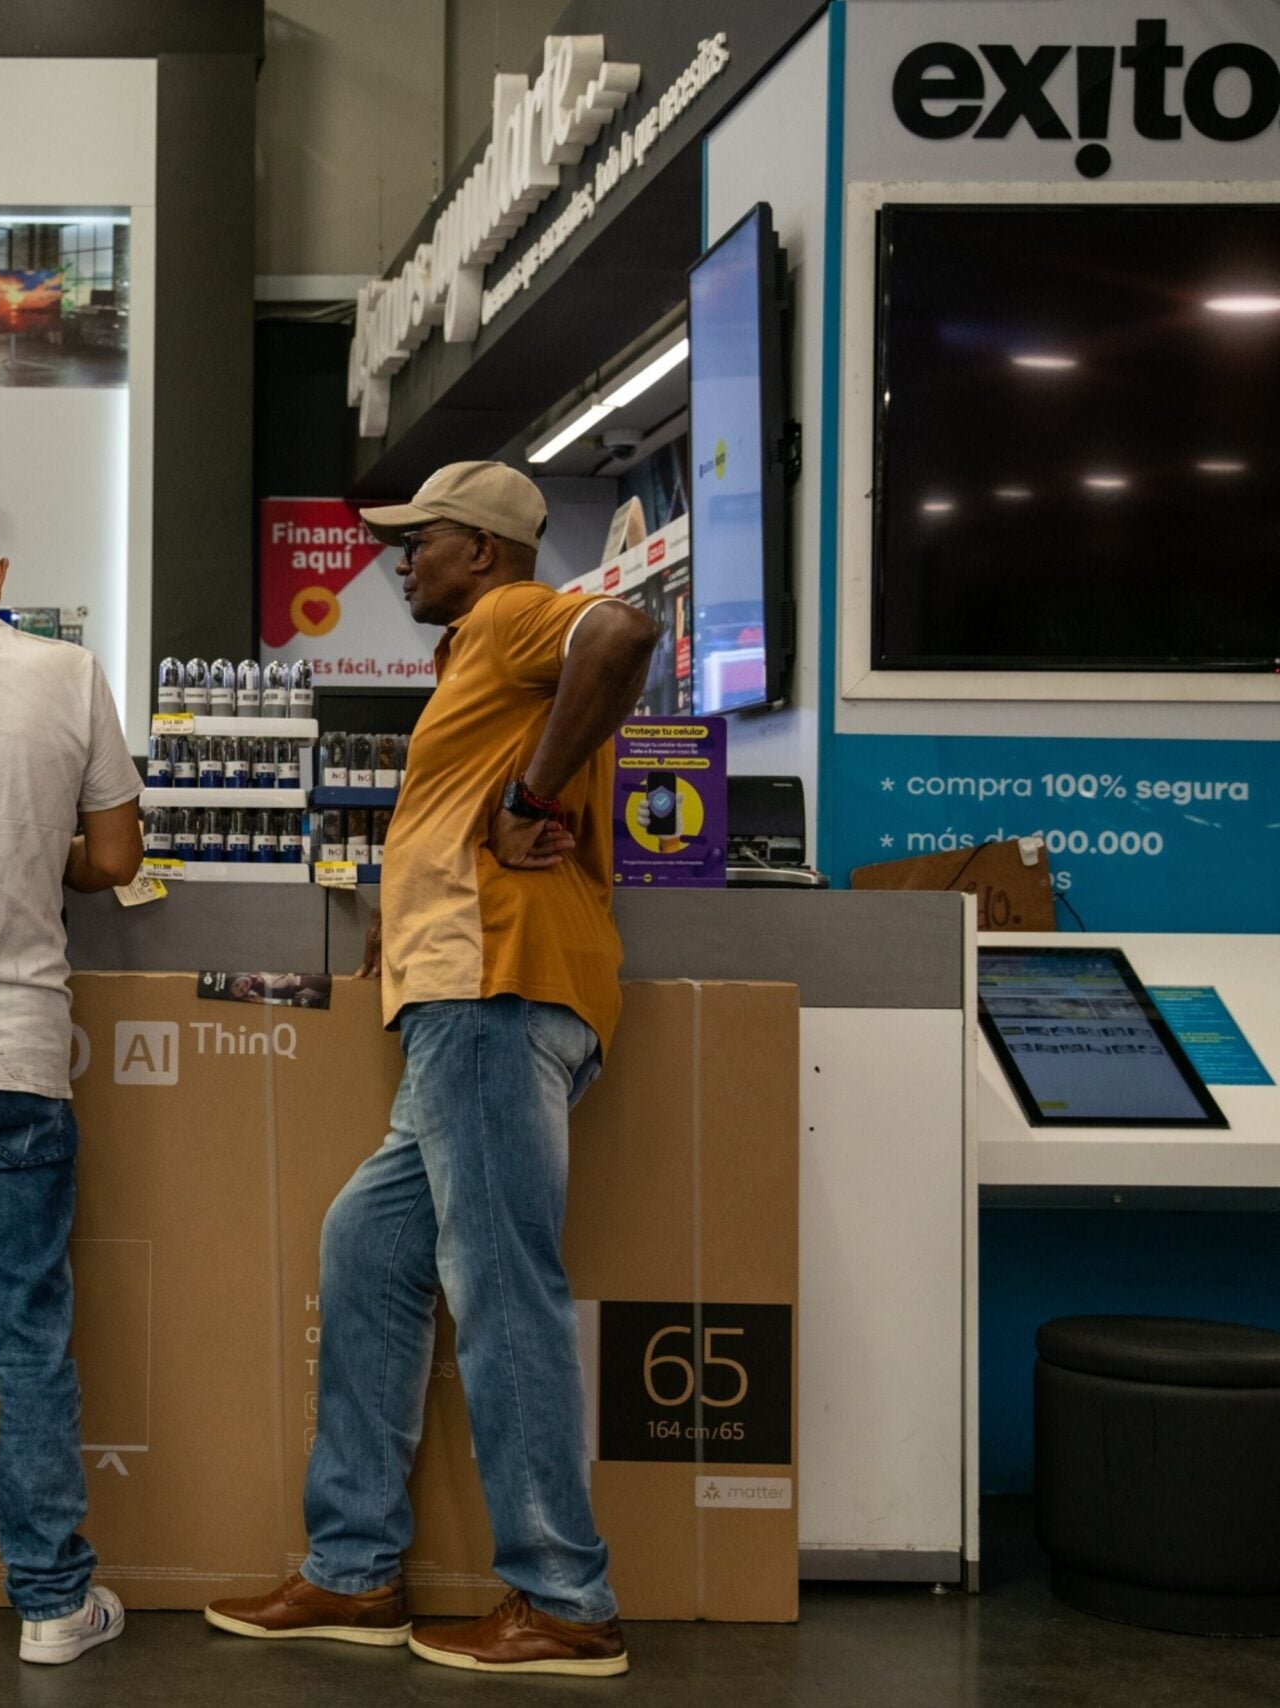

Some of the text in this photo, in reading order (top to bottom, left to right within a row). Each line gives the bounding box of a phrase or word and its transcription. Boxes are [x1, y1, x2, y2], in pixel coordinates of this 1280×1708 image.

[292, 547, 351, 574] aquí
[313, 658, 435, 678] Es fácil, rápid
[625, 727, 660, 737] Protege
[673, 727, 704, 735] celular
[907, 773, 1249, 805] compra 100% segura
[907, 827, 974, 851] más
[189, 1021, 298, 1060] ThinQ
[122, 1034, 172, 1073] AI
[643, 1325, 748, 1408] 65
[647, 1420, 681, 1439] 164
[728, 1483, 784, 1499] matter
